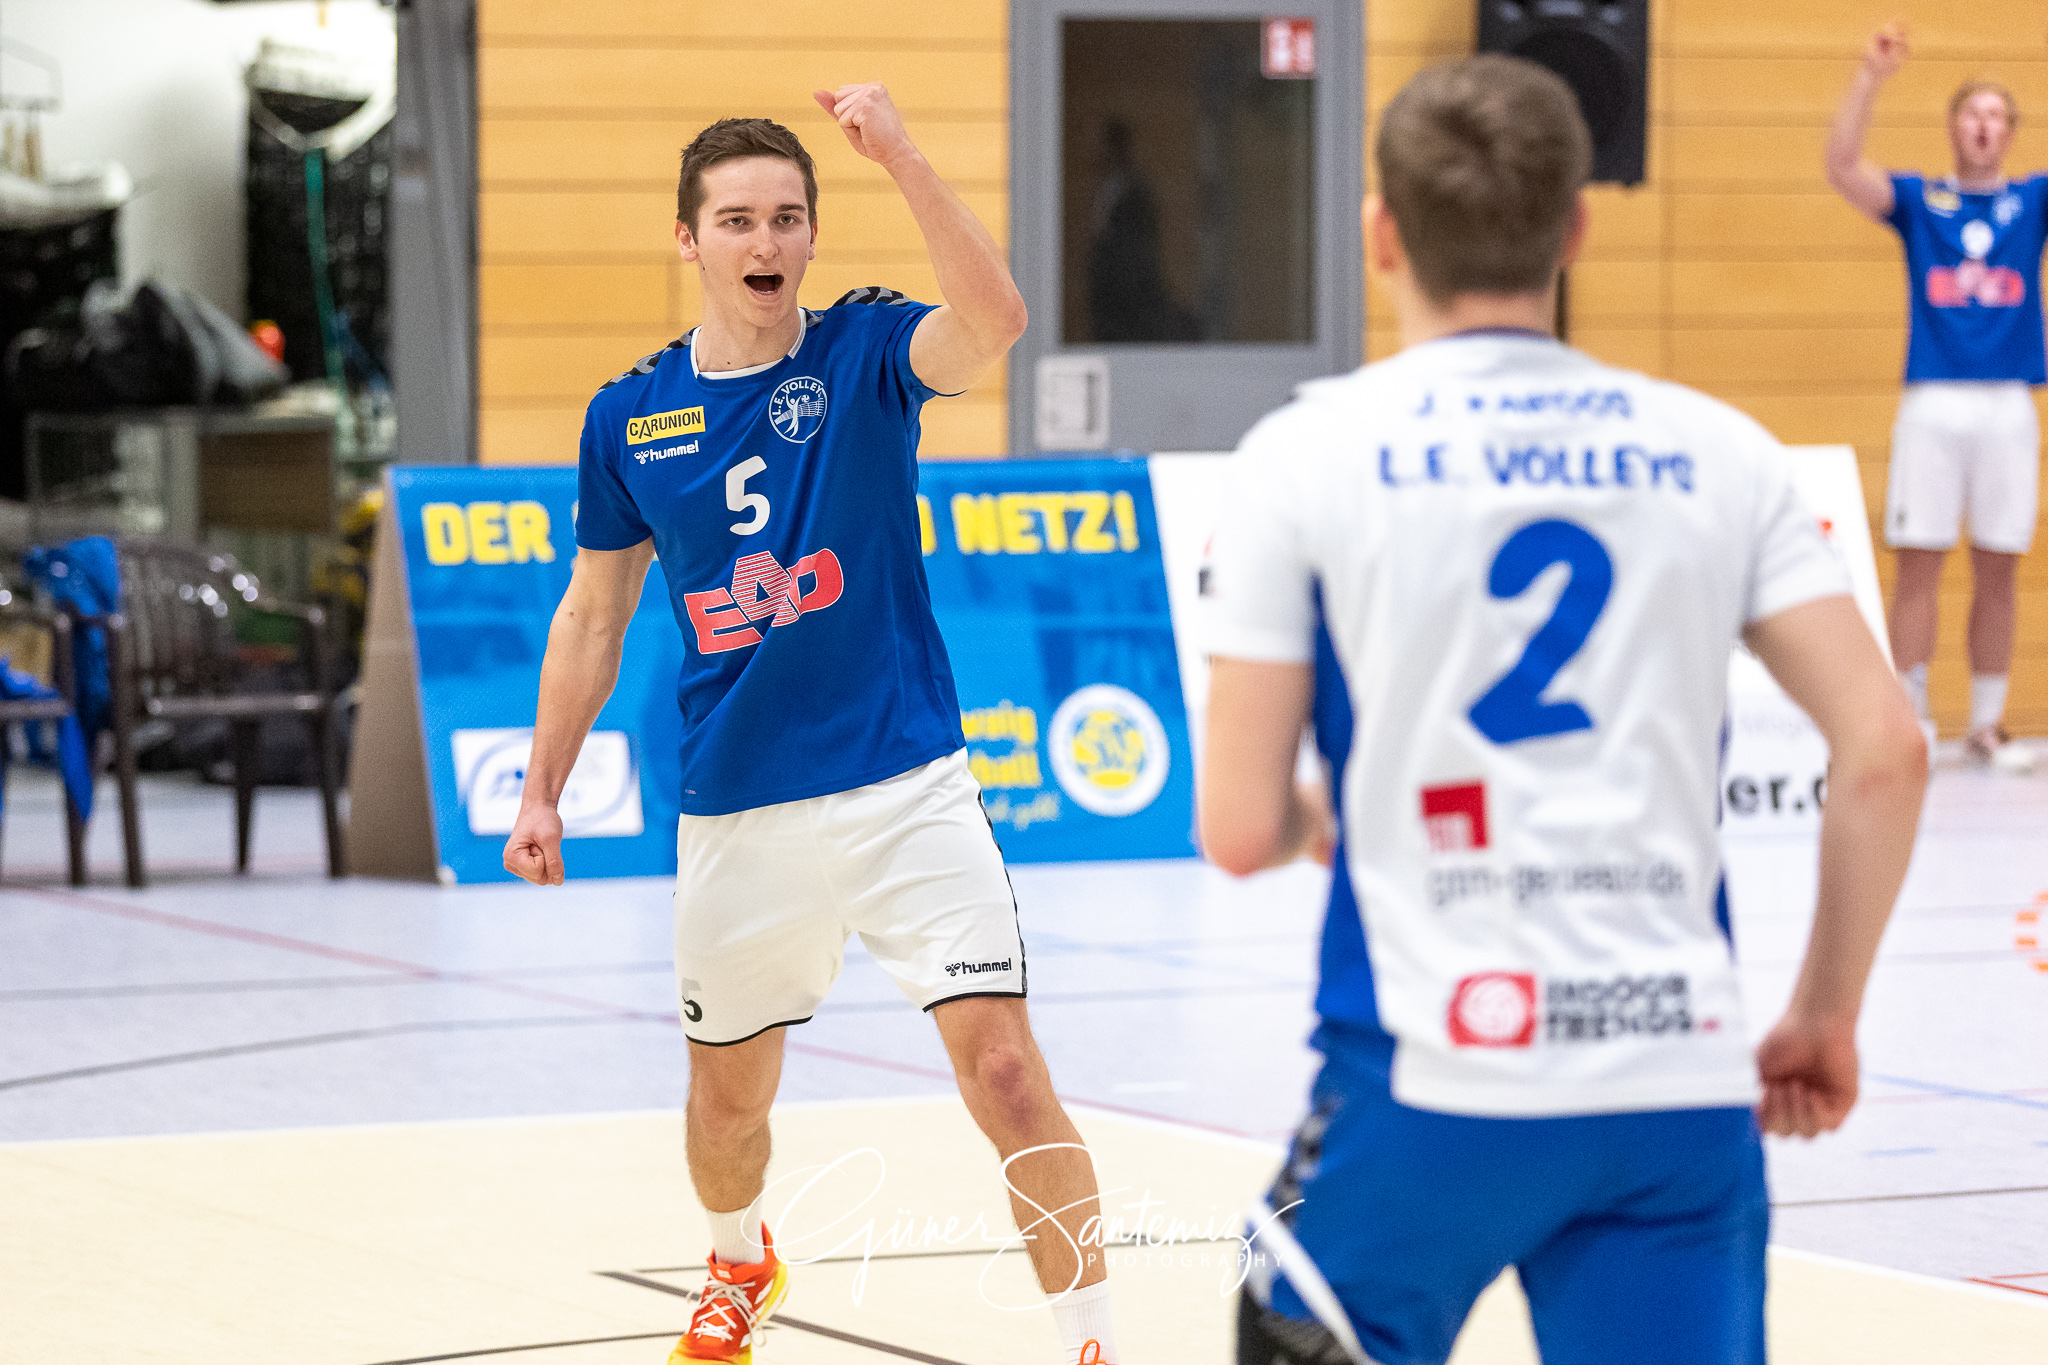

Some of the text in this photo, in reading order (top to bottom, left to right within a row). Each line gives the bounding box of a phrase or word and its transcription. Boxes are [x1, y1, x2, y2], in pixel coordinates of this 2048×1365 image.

[629, 411, 702, 439] CARUNION
[772, 395, 785, 416] L.E.
[650, 440, 700, 462] hummel
[1483, 443, 1696, 494] VOLLEYS
[726, 455, 771, 536] 5
[421, 500, 556, 566] DER
[951, 490, 1140, 555] NETZ!
[1467, 519, 1613, 745] 2
[962, 957, 1013, 975] hummel
